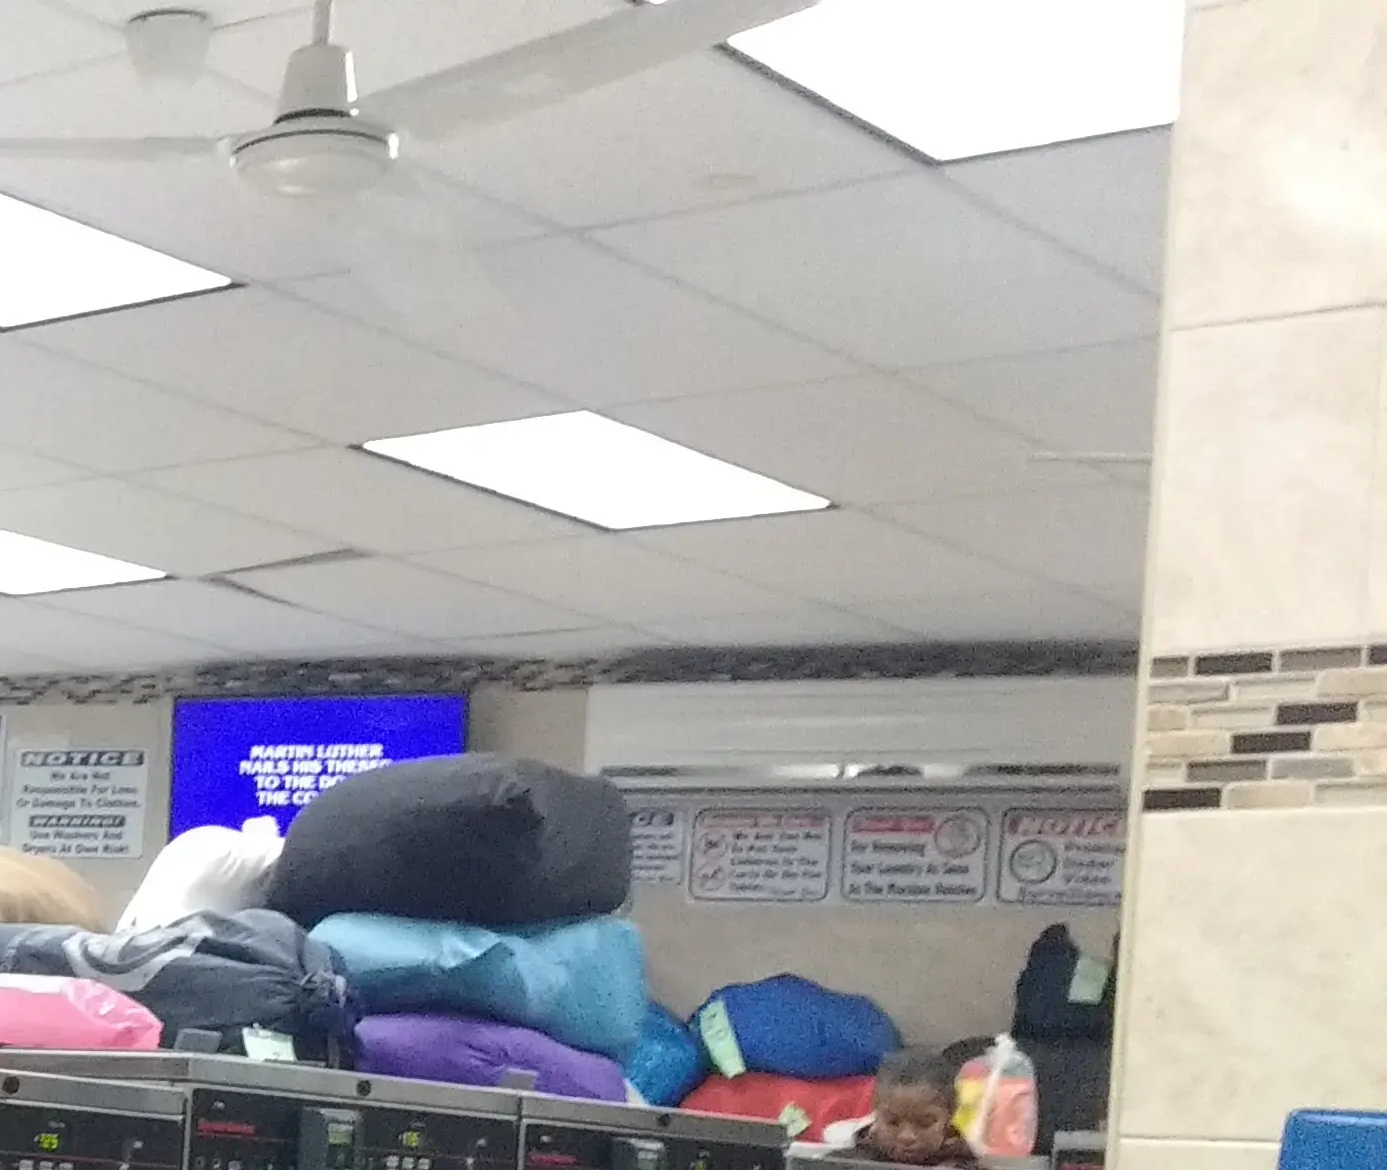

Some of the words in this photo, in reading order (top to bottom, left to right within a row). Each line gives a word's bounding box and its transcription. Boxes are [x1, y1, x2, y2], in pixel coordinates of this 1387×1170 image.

[24, 751, 142, 766] NOTICE
[250, 744, 314, 760] MARTIN
[316, 743, 384, 760] LUTHER
[239, 760, 290, 776] NAILS
[292, 760, 322, 774] HIS
[254, 775, 281, 790] TO
[283, 775, 317, 790] THE
[256, 790, 291, 806] THE
